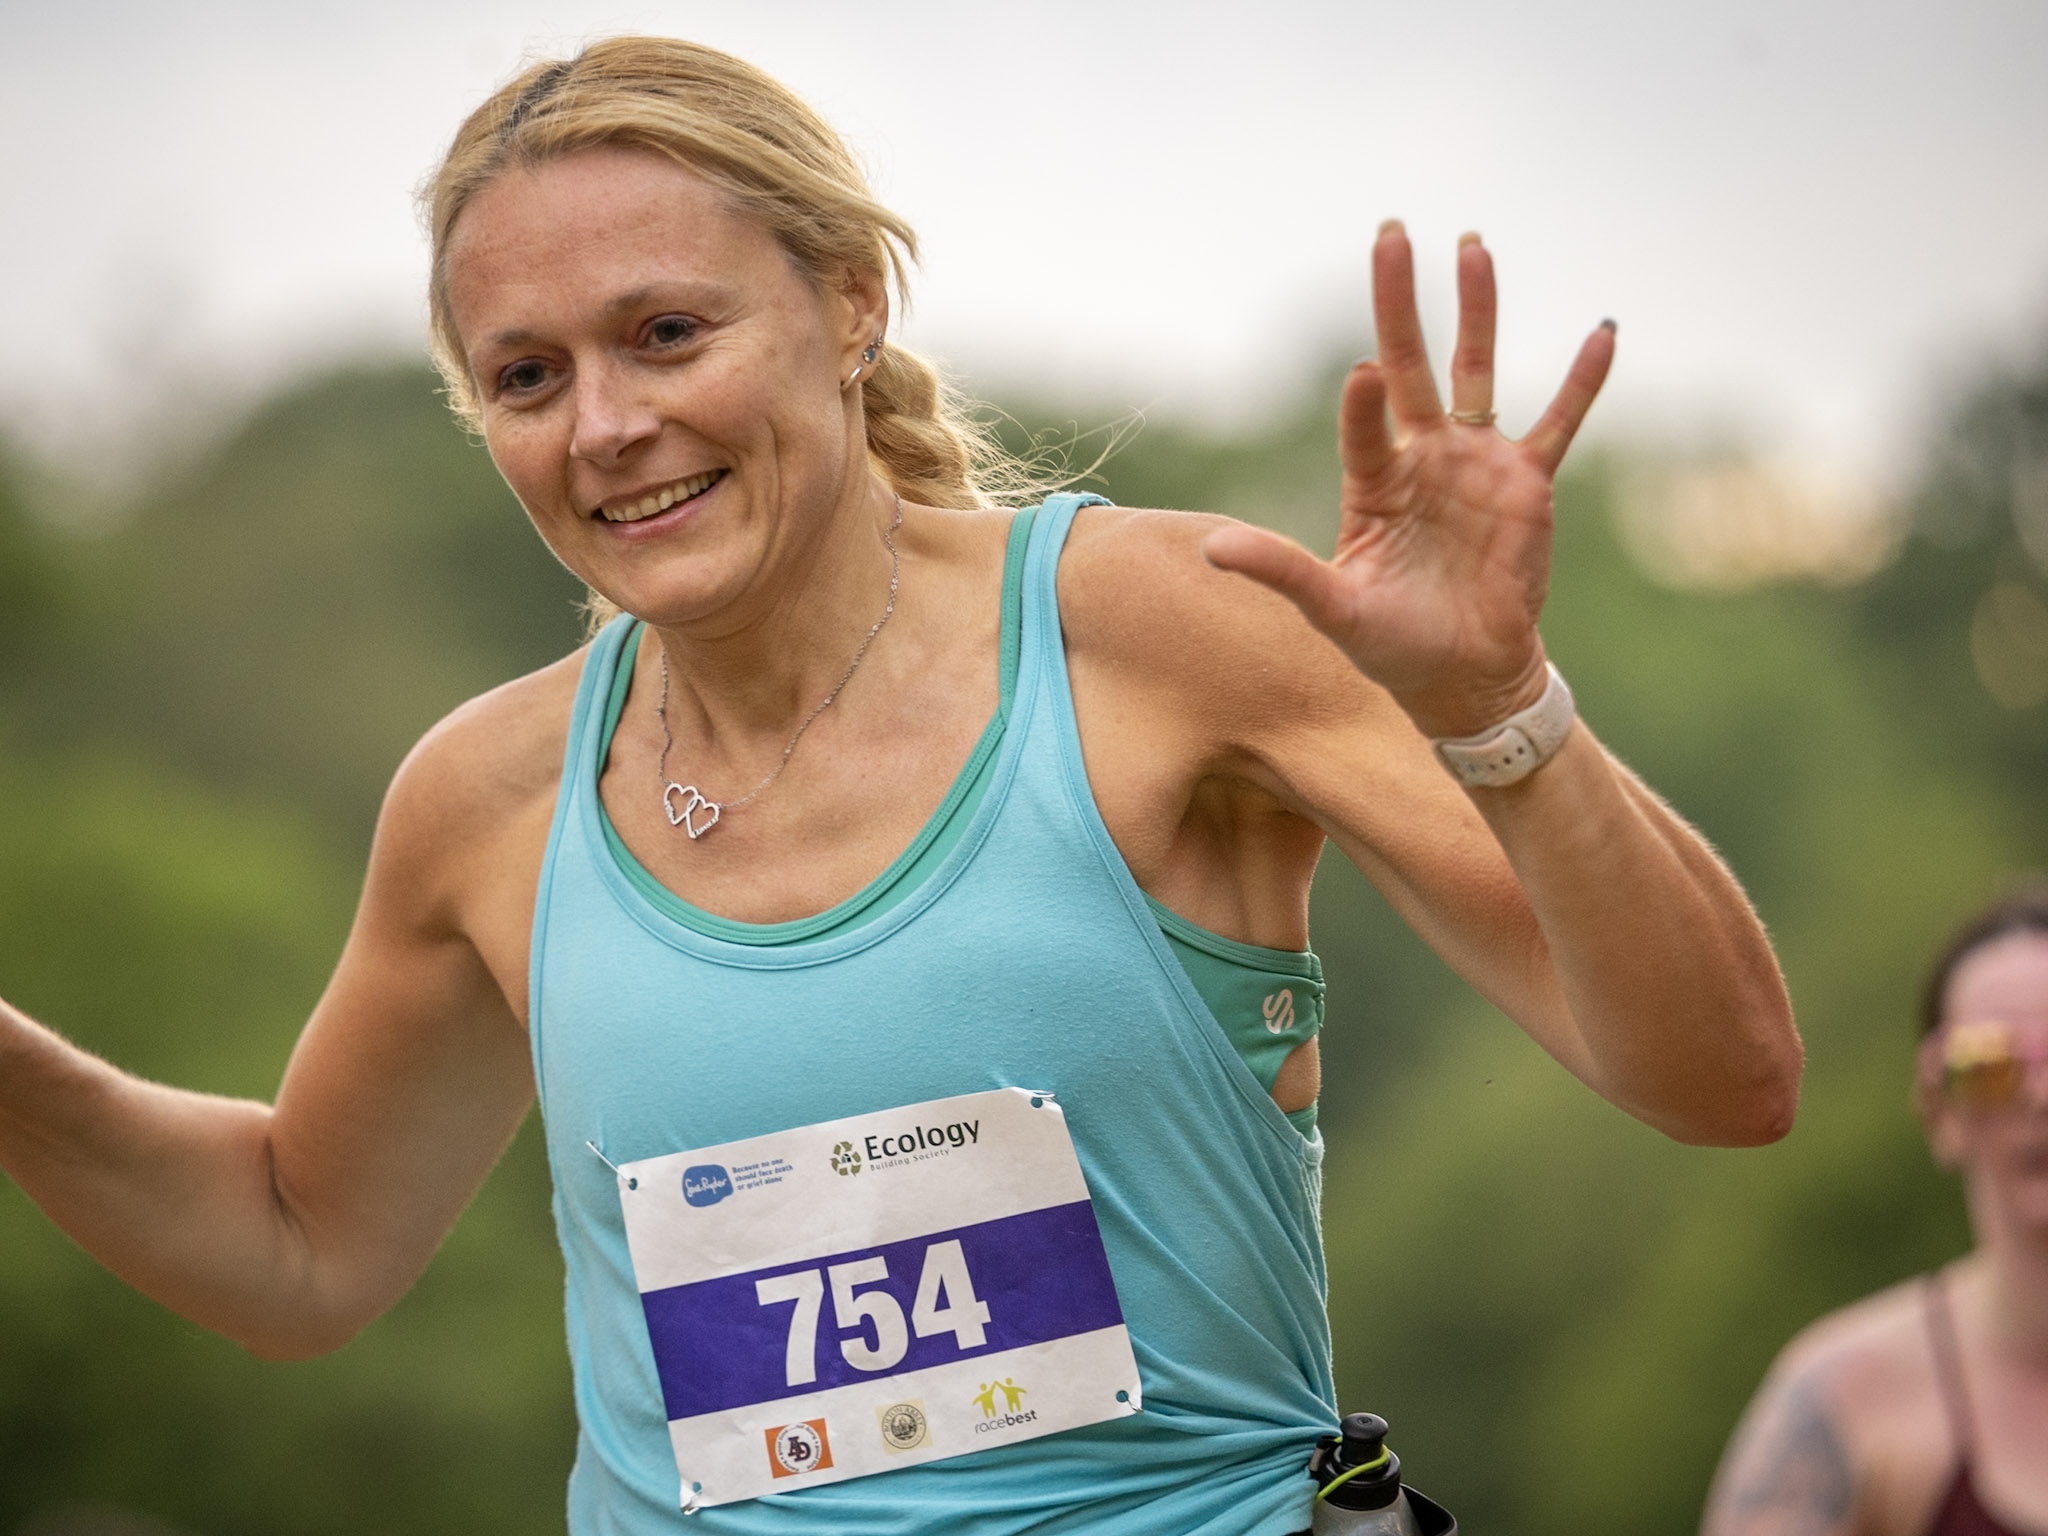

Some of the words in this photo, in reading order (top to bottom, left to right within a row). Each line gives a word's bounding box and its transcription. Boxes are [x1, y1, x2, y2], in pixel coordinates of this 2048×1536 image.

[864, 1120, 979, 1160] Ecology
[732, 1164, 759, 1173] Because
[870, 1157, 910, 1171] Building
[913, 1148, 950, 1161] Society
[755, 1239, 992, 1387] 754
[975, 1409, 1038, 1434] racebest
